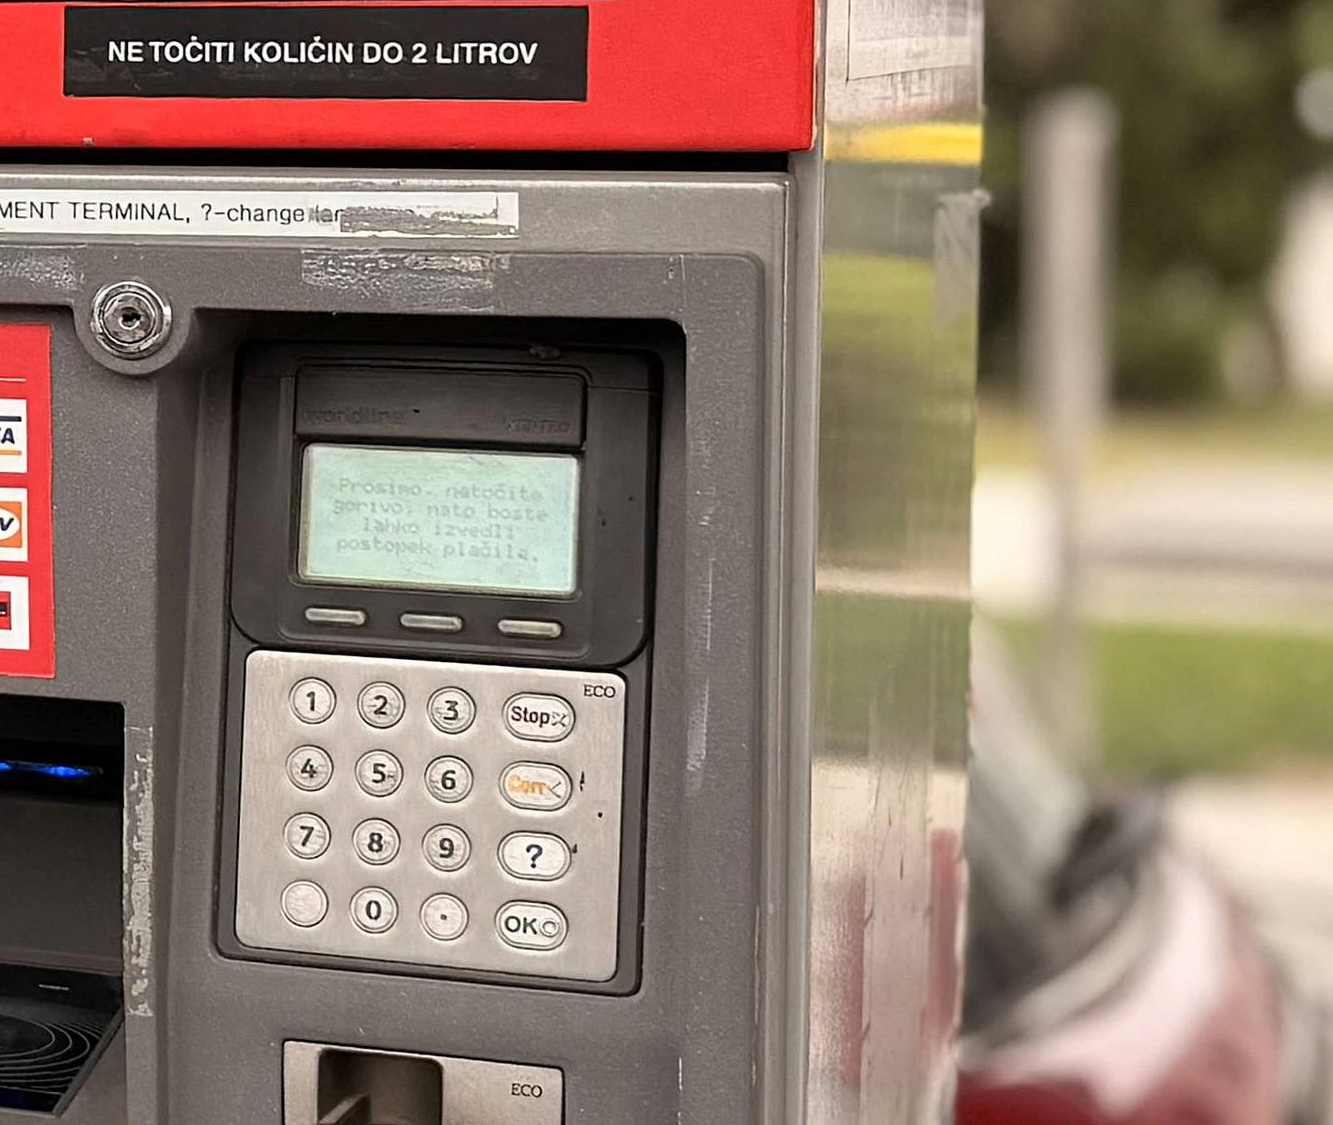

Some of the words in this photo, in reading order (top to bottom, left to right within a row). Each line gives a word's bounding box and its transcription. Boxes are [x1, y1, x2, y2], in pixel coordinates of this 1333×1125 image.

[107, 41, 143, 64] NE
[150, 35, 235, 64] TOČITI
[243, 34, 353, 64] KOLIČIN
[363, 42, 404, 64] DO
[411, 42, 428, 64] 2
[435, 42, 538, 65] LITROV
[68, 200, 192, 225] TERMINAL,
[427, 504, 476, 518] nato
[487, 505, 549, 522] boste
[364, 517, 419, 533] lahko
[434, 523, 515, 540] izvedli
[336, 536, 432, 555] postopek
[443, 541, 538, 562] plačila.
[584, 685, 616, 698] ECO
[511, 706, 550, 728] Stop
[504, 915, 538, 935] OK
[511, 1083, 543, 1098] ECO
